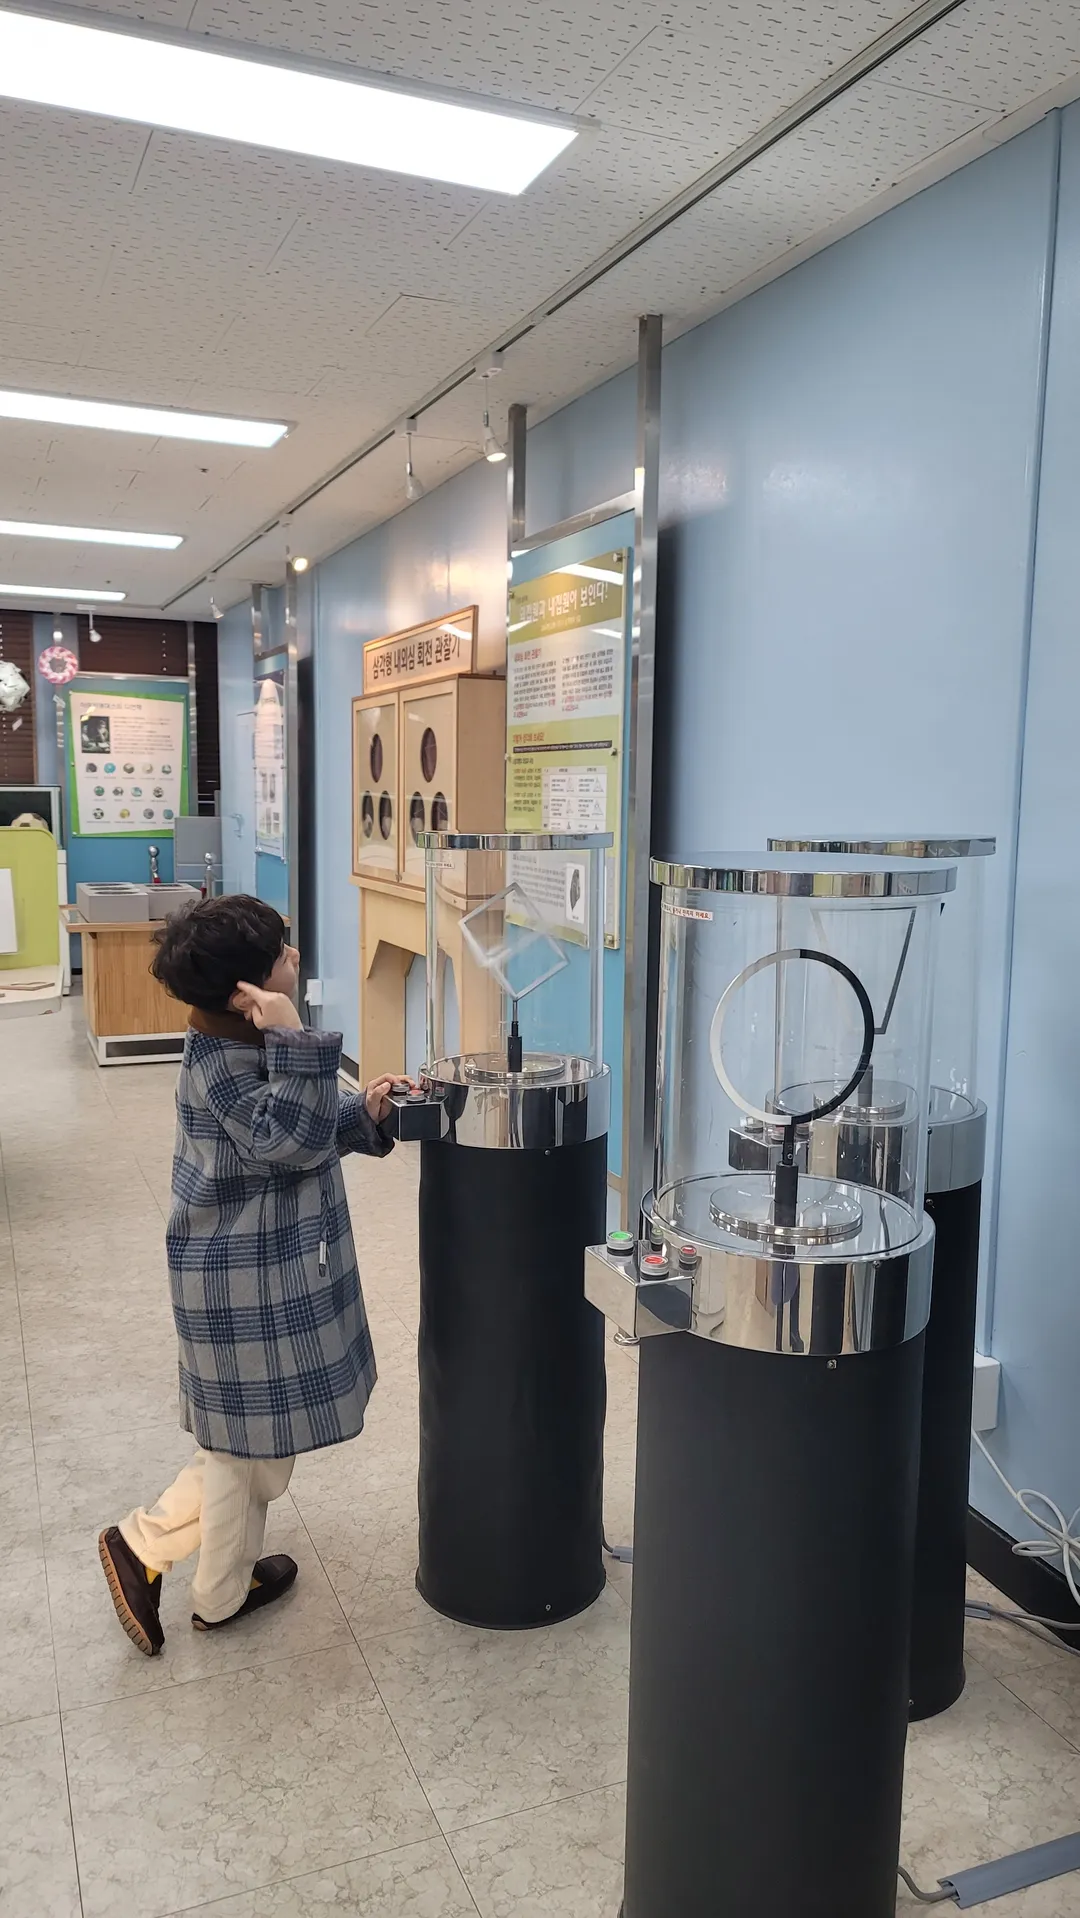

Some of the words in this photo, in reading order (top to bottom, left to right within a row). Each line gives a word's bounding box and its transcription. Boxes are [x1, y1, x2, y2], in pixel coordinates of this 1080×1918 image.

[548, 589, 577, 617] 내접원이
[580, 581, 608, 608] 보인다!
[372, 651, 393, 679] 삼각형
[394, 643, 416, 674] 내외심
[417, 637, 433, 668] 회전
[434, 634, 460, 664] 관찰기
